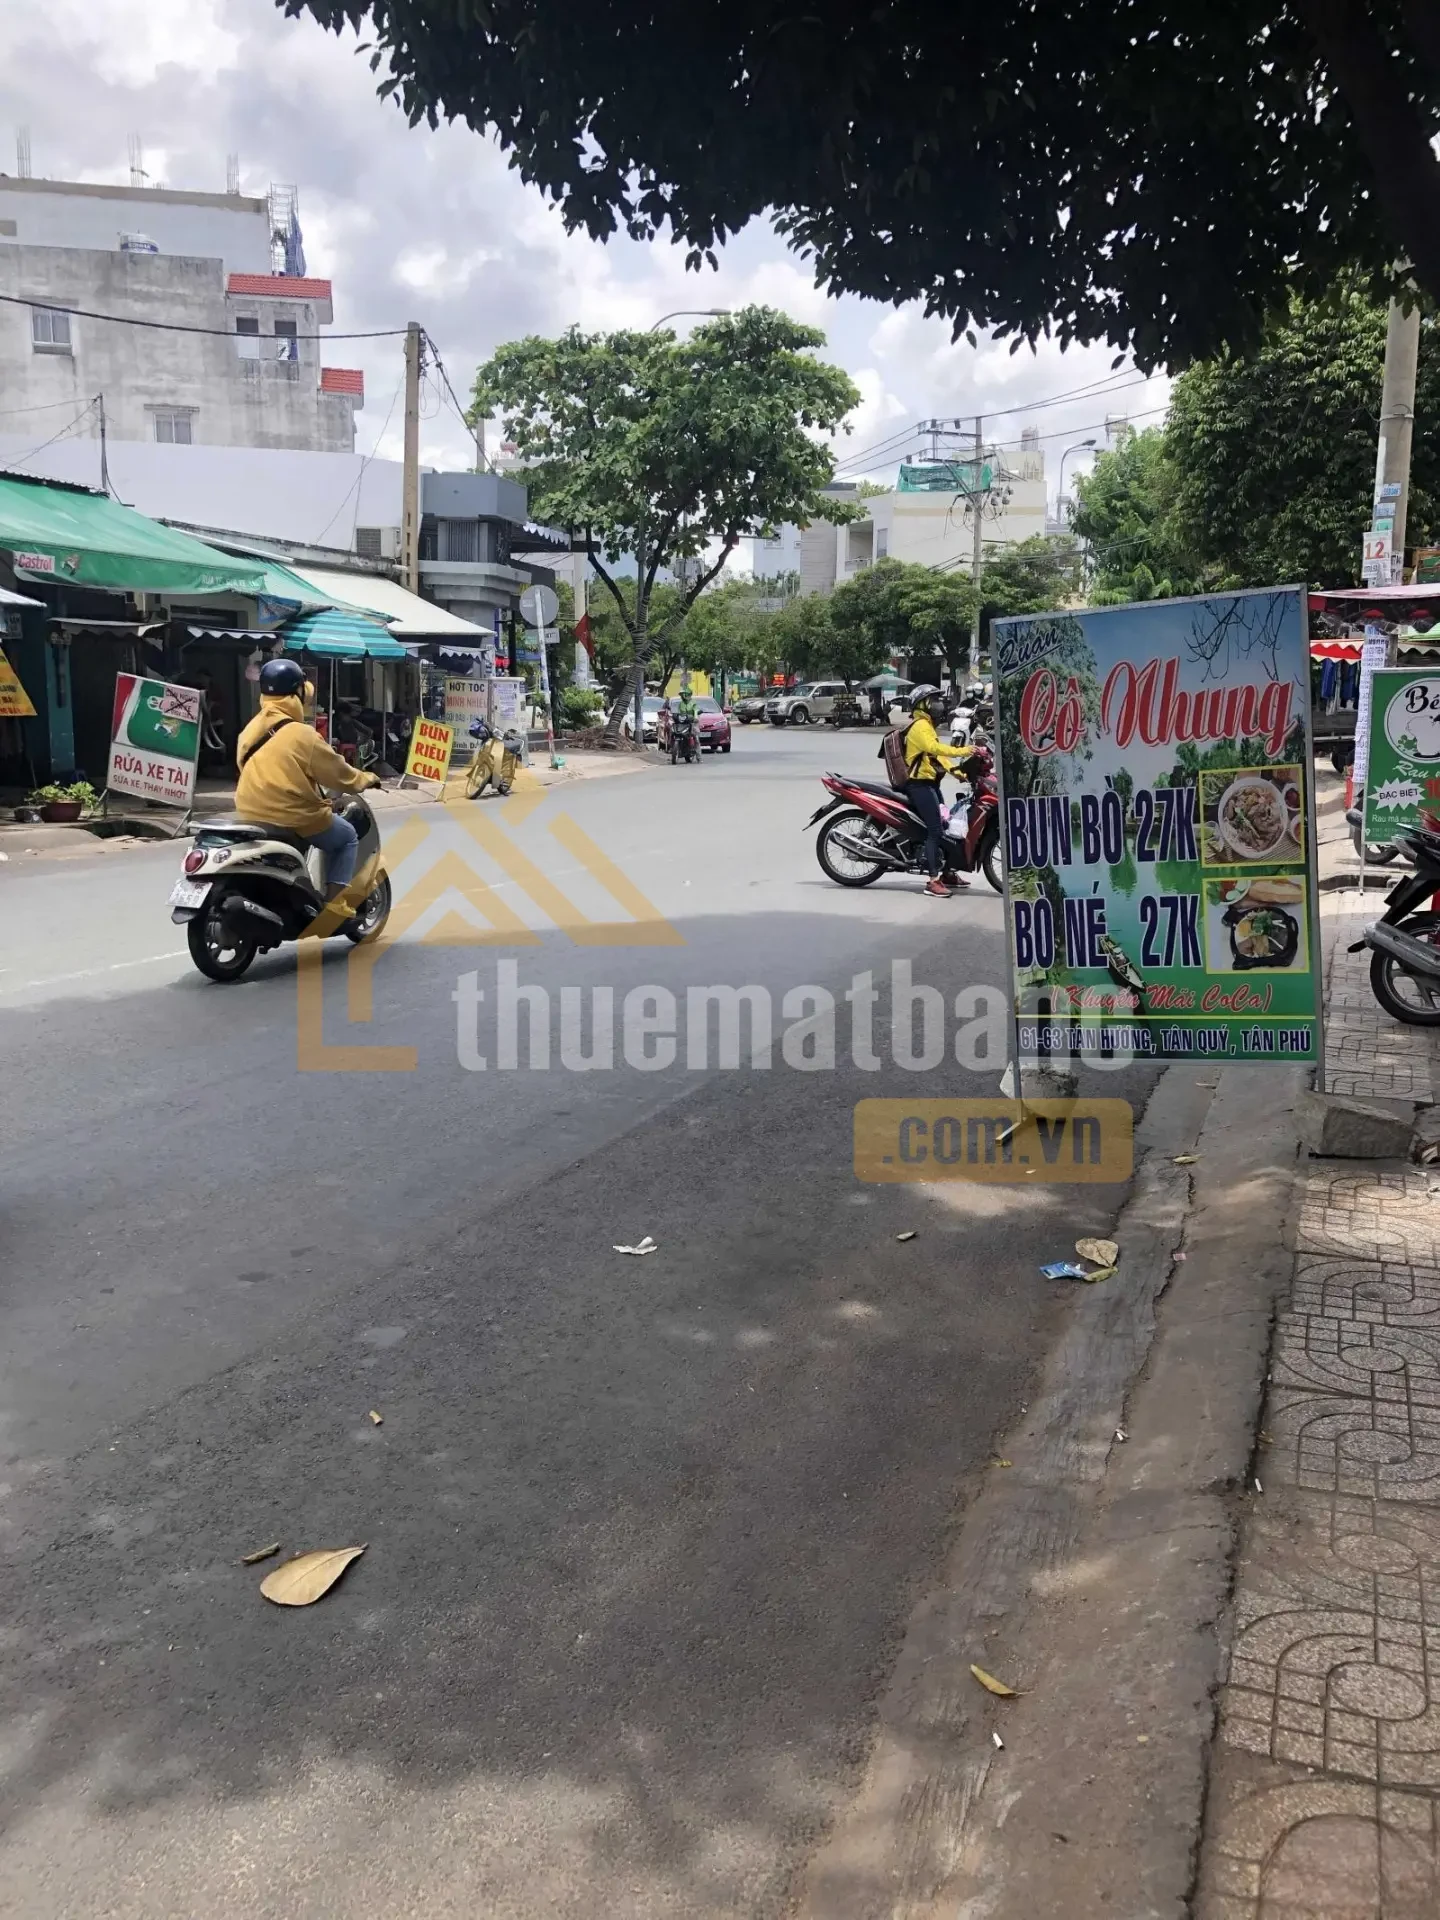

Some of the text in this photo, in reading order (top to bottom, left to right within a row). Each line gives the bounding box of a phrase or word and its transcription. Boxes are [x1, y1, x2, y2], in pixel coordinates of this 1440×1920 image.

[18, 553, 53, 571] Castrol
[998, 625, 1059, 675] Quán
[1020, 656, 1299, 758] Cô Nhung
[114, 752, 189, 787] RỬA XE TÀI
[412, 762, 441, 781] CUA
[1392, 760, 1429, 779] Rau
[143, 781, 163, 794] THAY
[1008, 775, 1199, 870] BÚN BÒ 27K
[1013, 880, 1204, 969] BÒ NÉ 27K
[1145, 984, 1196, 1010] Mãi
[1020, 1026, 1063, 1050] 61-63
[1065, 1023, 1097, 1051] TÂN
[1160, 1023, 1194, 1052] TÂN
[1240, 1023, 1275, 1053] TÂN
[1278, 1023, 1312, 1053] PHÚ
